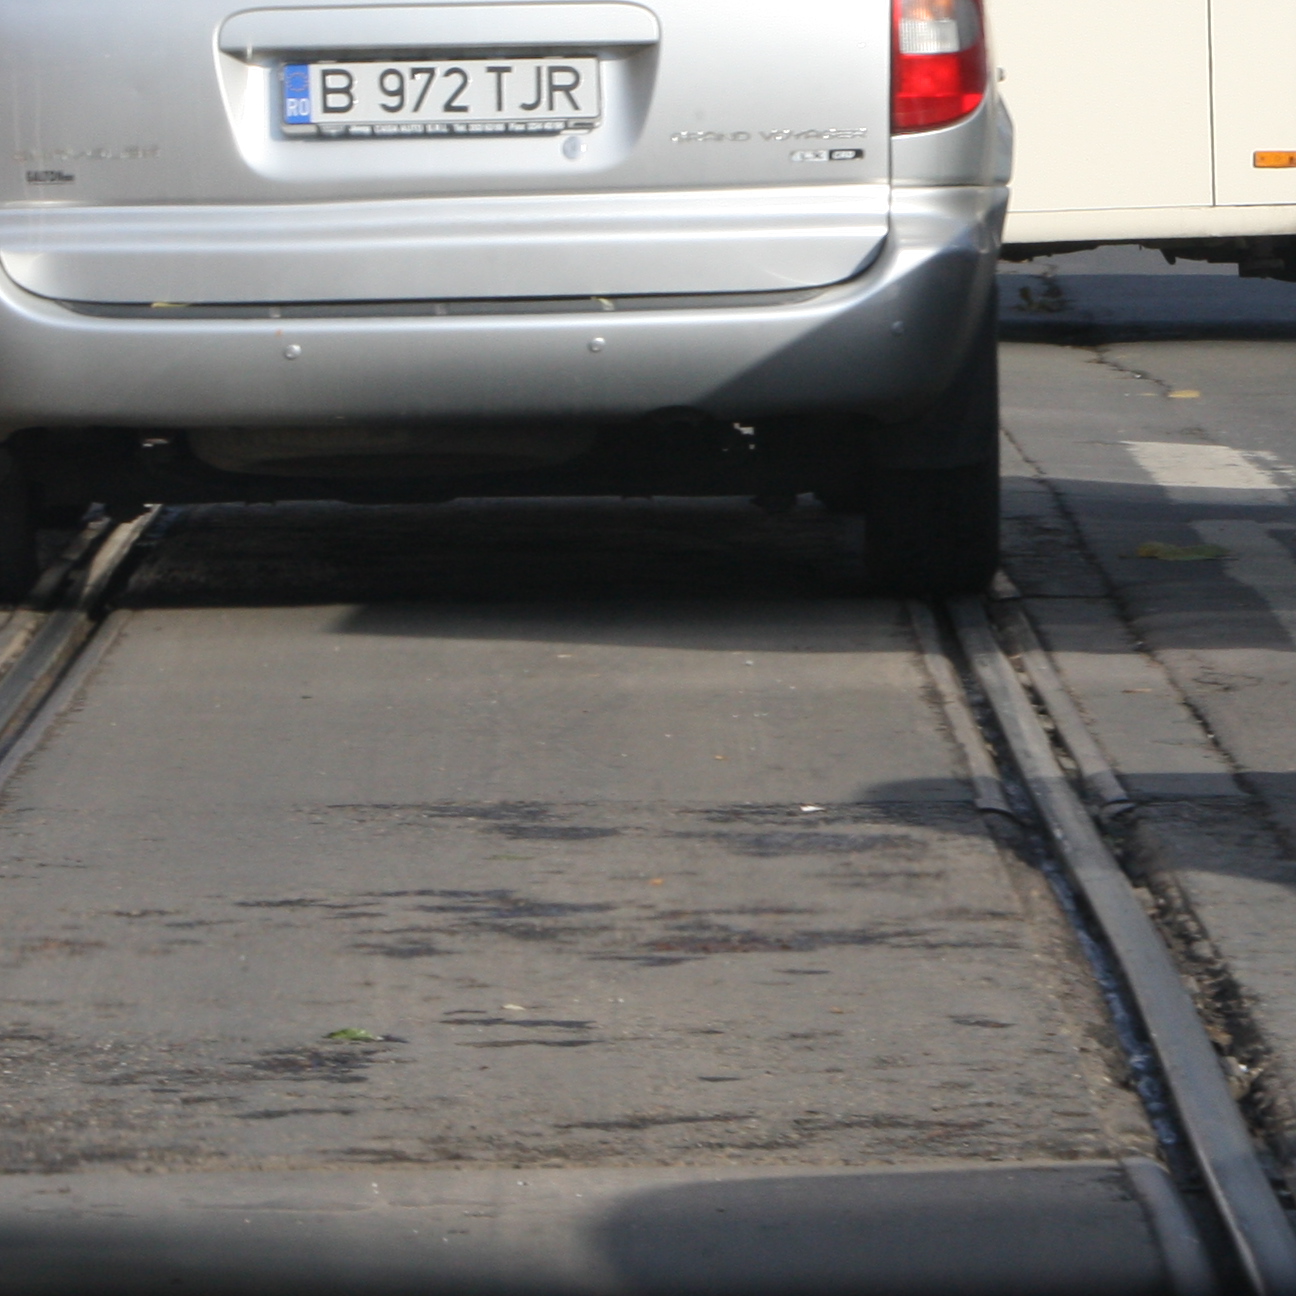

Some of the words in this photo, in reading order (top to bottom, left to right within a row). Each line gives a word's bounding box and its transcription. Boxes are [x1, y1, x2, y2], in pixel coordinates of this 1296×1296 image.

[320, 68, 355, 114] B
[378, 66, 471, 113] 972
[485, 65, 582, 112] TJR
[286, 97, 310, 117] RO
[670, 130, 751, 143] GRAND
[759, 127, 868, 142] VOYAGER
